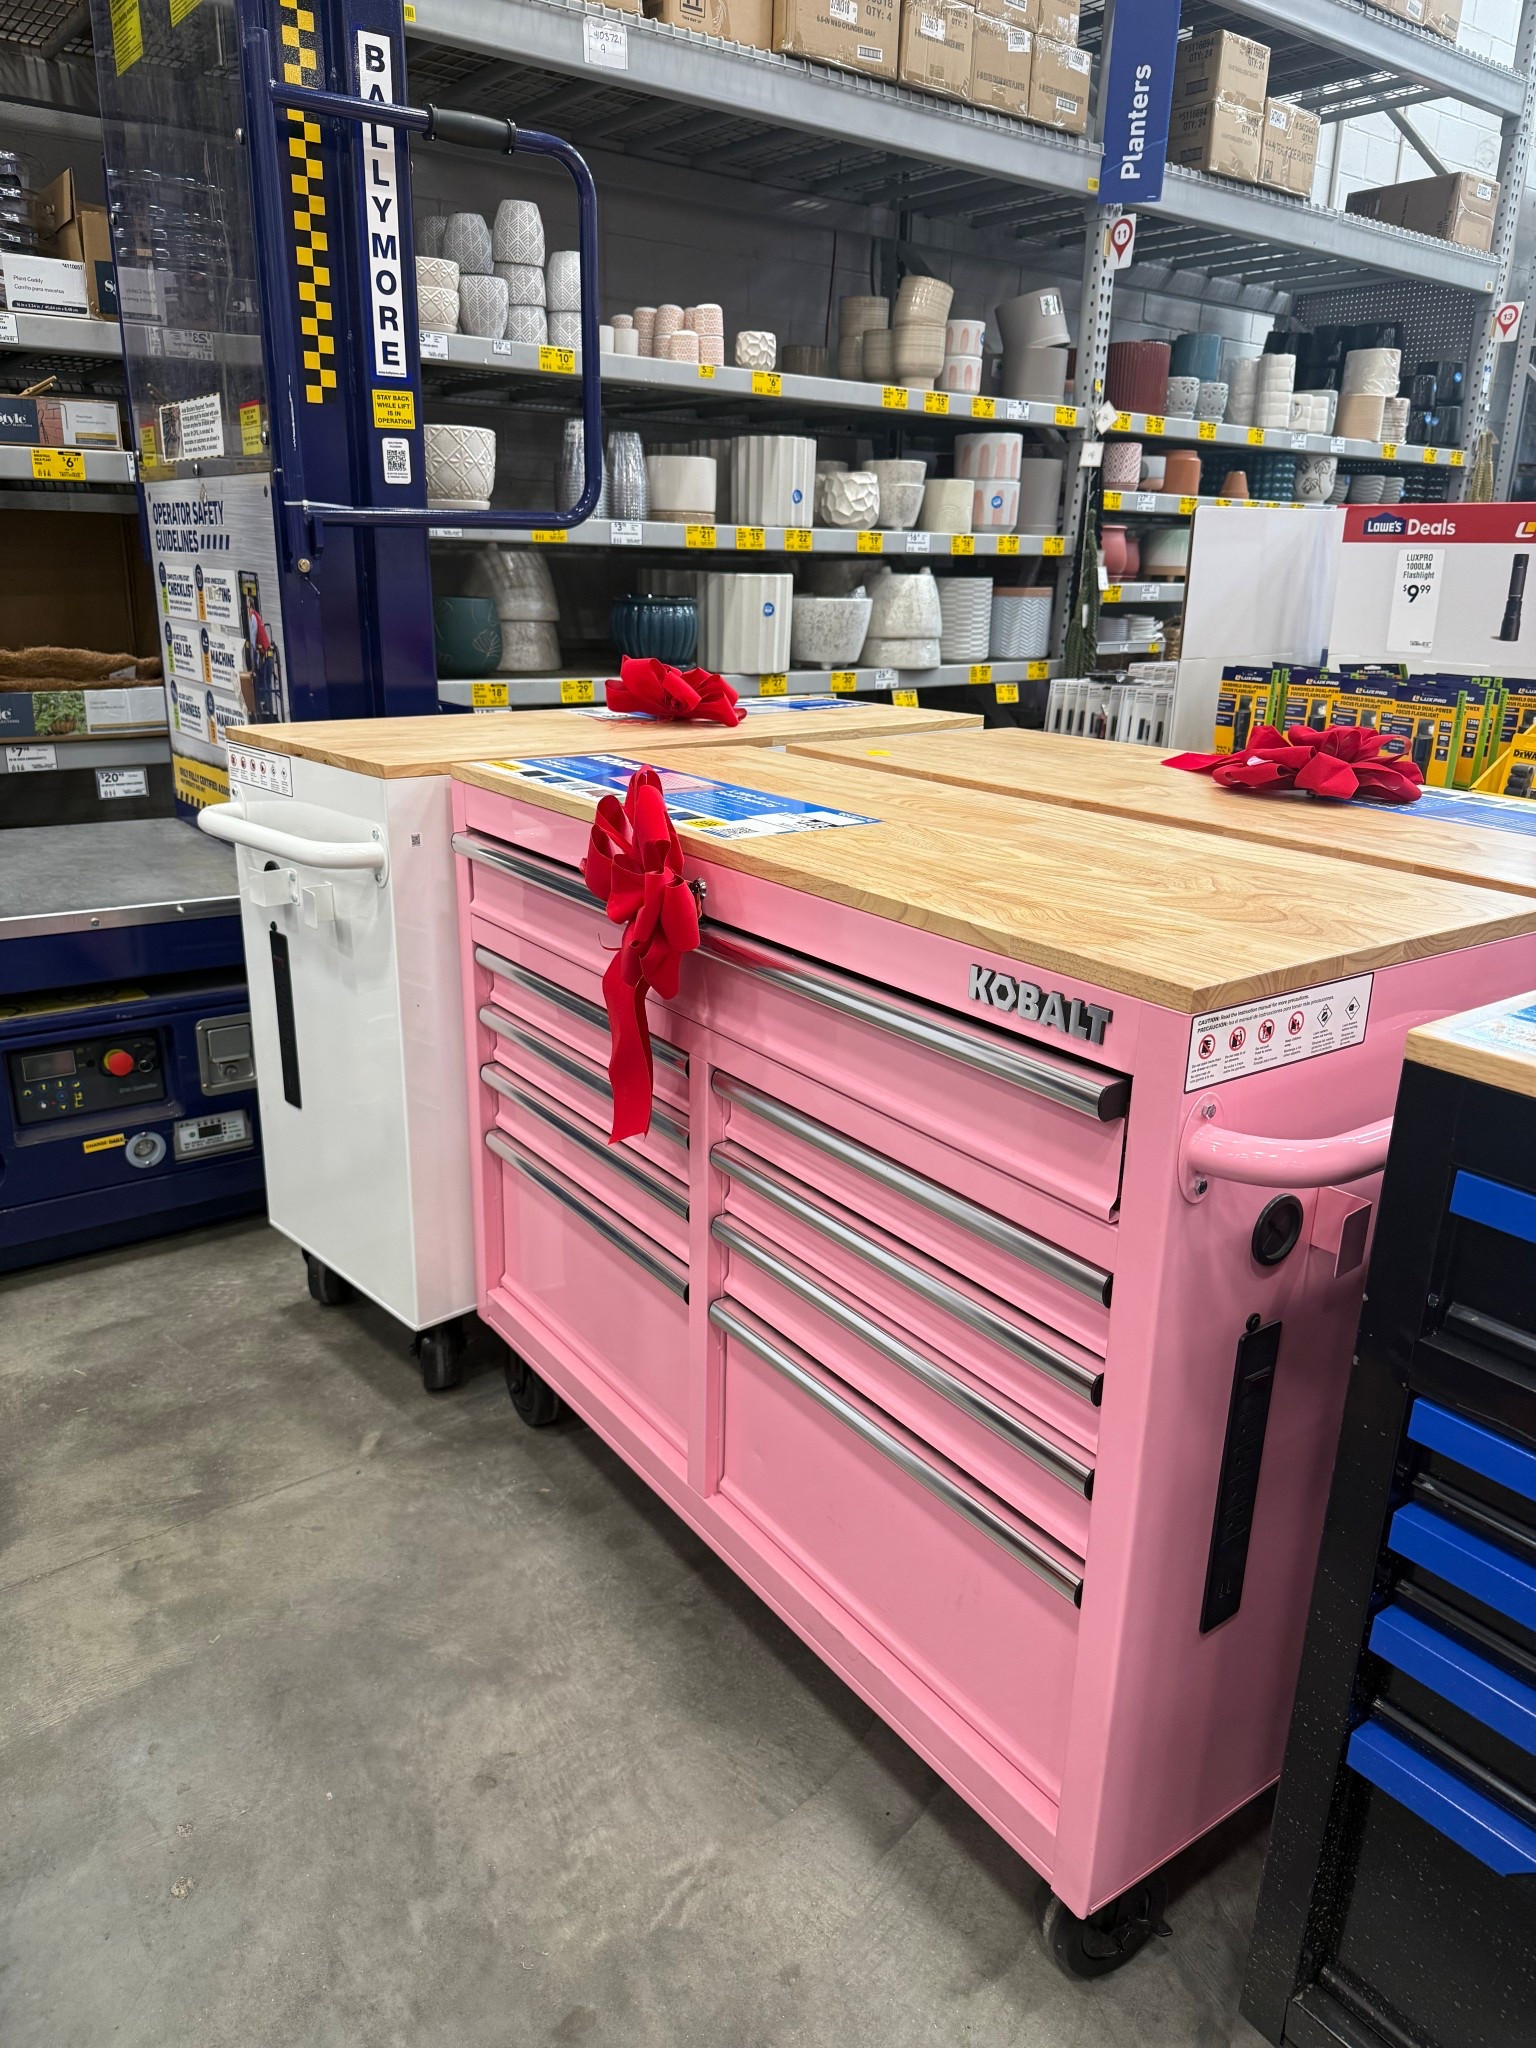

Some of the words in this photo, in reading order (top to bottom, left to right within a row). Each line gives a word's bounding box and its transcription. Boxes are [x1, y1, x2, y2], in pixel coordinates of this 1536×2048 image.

[866, 6, 884, 20] QTY:
[886, 12, 892, 22] 4
[600, 44, 606, 54] 9
[1120, 64, 1152, 180] Planters
[364, 44, 400, 367] BALLYMORE
[1117, 230, 1127, 240] 11
[27, 276, 44, 284] Caddy
[1504, 312, 1512, 321] 13
[152, 502, 192, 526] OPERATOR
[192, 500, 224, 525] SAFETY
[1367, 521, 1403, 533] LOWE'S
[1407, 518, 1456, 536] Deals
[156, 530, 199, 553] GUIDELINES
[1403, 571, 1434, 580] Flashlight
[168, 583, 194, 599] CHECKLIST
[174, 642, 182, 656] 650
[182, 644, 194, 658] LBS.
[210, 650, 235, 668] MACHINE
[178, 700, 200, 719] HARNESS
[1422, 706, 1452, 714] DUAL-POWER
[1514, 749, 1536, 760] DEWA
[968, 964, 1114, 1045] KOBALT
[1198, 1016, 1220, 1026] CAUTION:
[1238, 1006, 1258, 1016] instruction
[85, 1139, 108, 1150] CHARGE
[108, 1136, 124, 1146] DAILY
